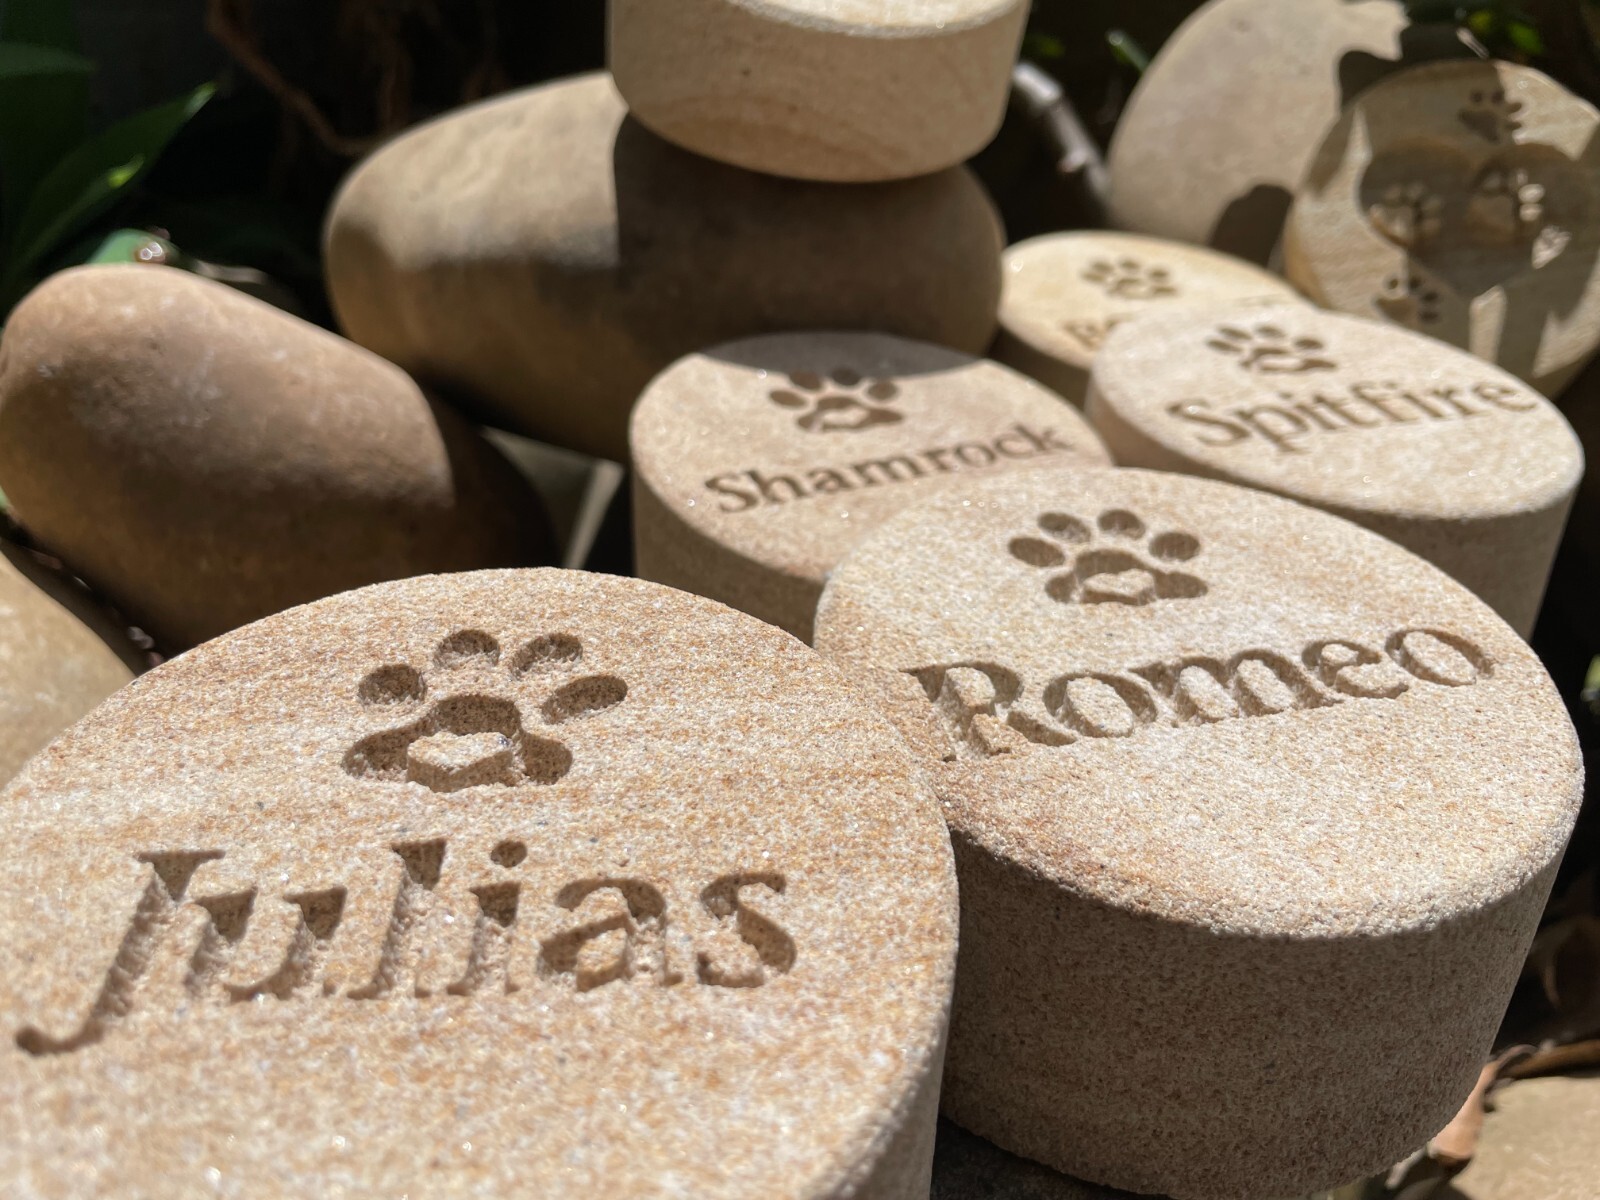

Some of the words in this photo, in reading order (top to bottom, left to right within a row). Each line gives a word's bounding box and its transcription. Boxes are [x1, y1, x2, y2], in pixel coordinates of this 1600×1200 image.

[704, 423, 1074, 512] Shamrock
[1166, 379, 1539, 454] Spitfire
[901, 627, 1497, 762] Romeo
[16, 838, 797, 1056] Julias
